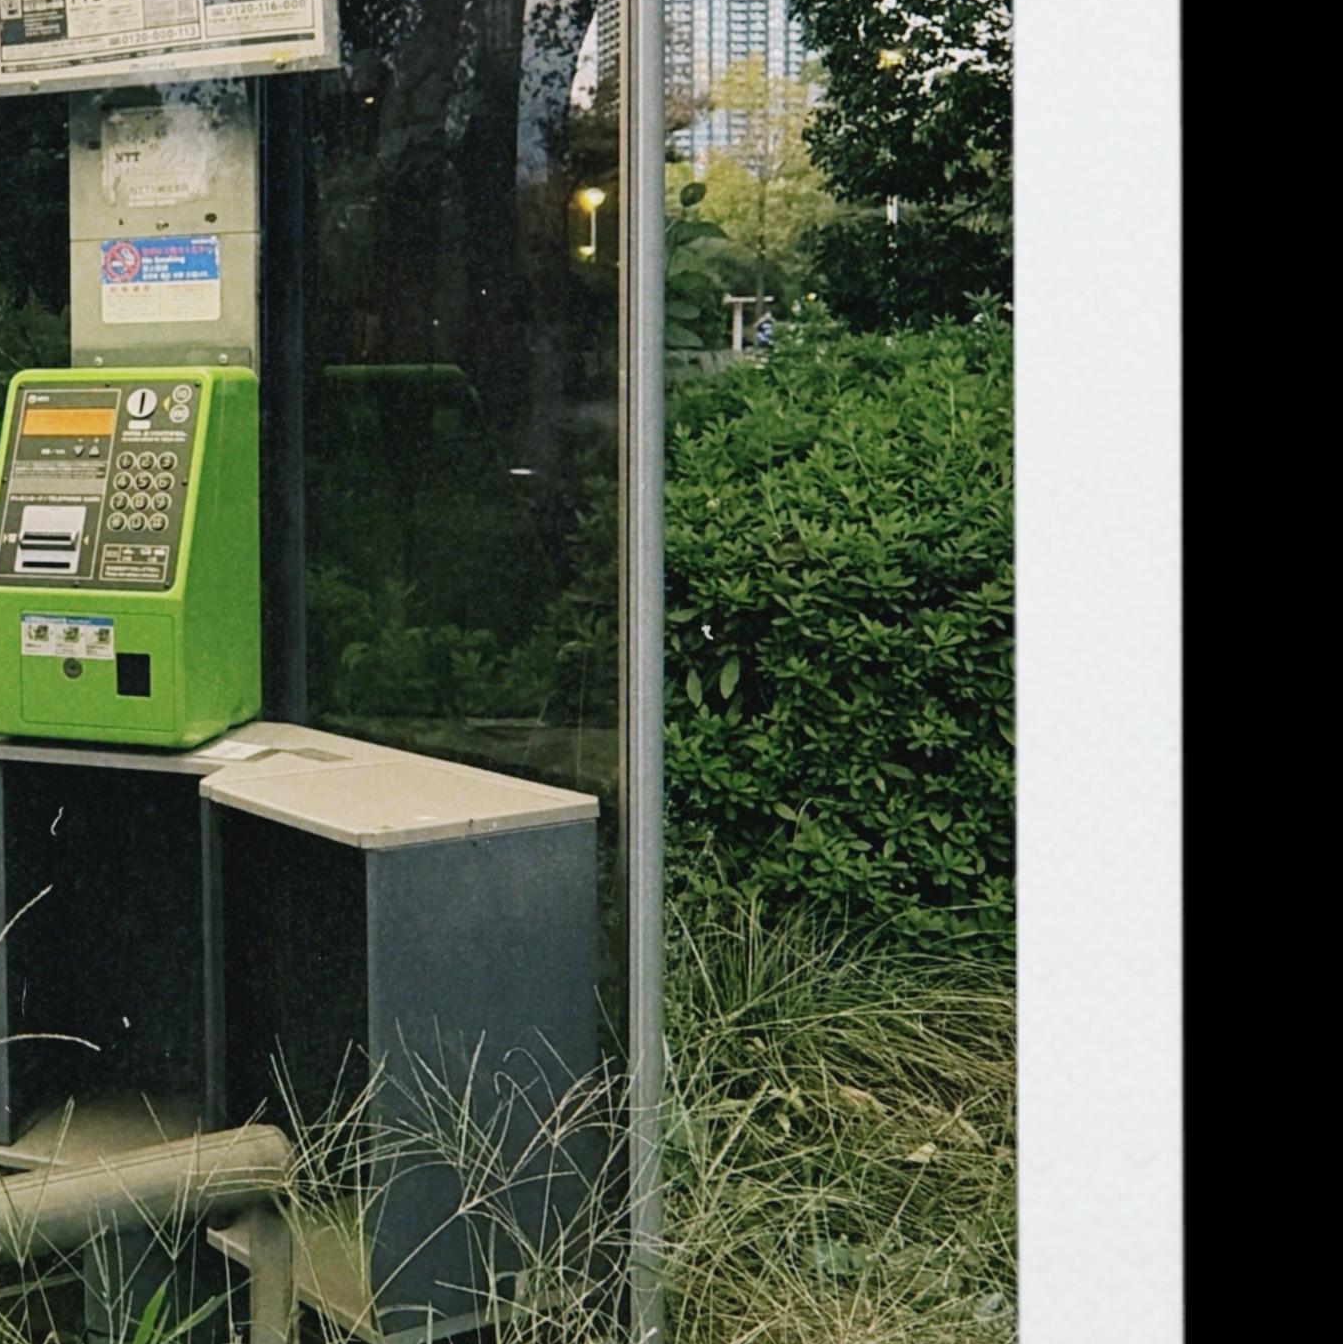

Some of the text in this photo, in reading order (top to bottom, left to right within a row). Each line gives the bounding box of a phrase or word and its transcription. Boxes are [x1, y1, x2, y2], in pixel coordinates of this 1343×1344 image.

[226, 0, 306, 16] 0120-116-000
[122, 26, 197, 45] 0120-000-113
[115, 151, 141, 163] NTT
